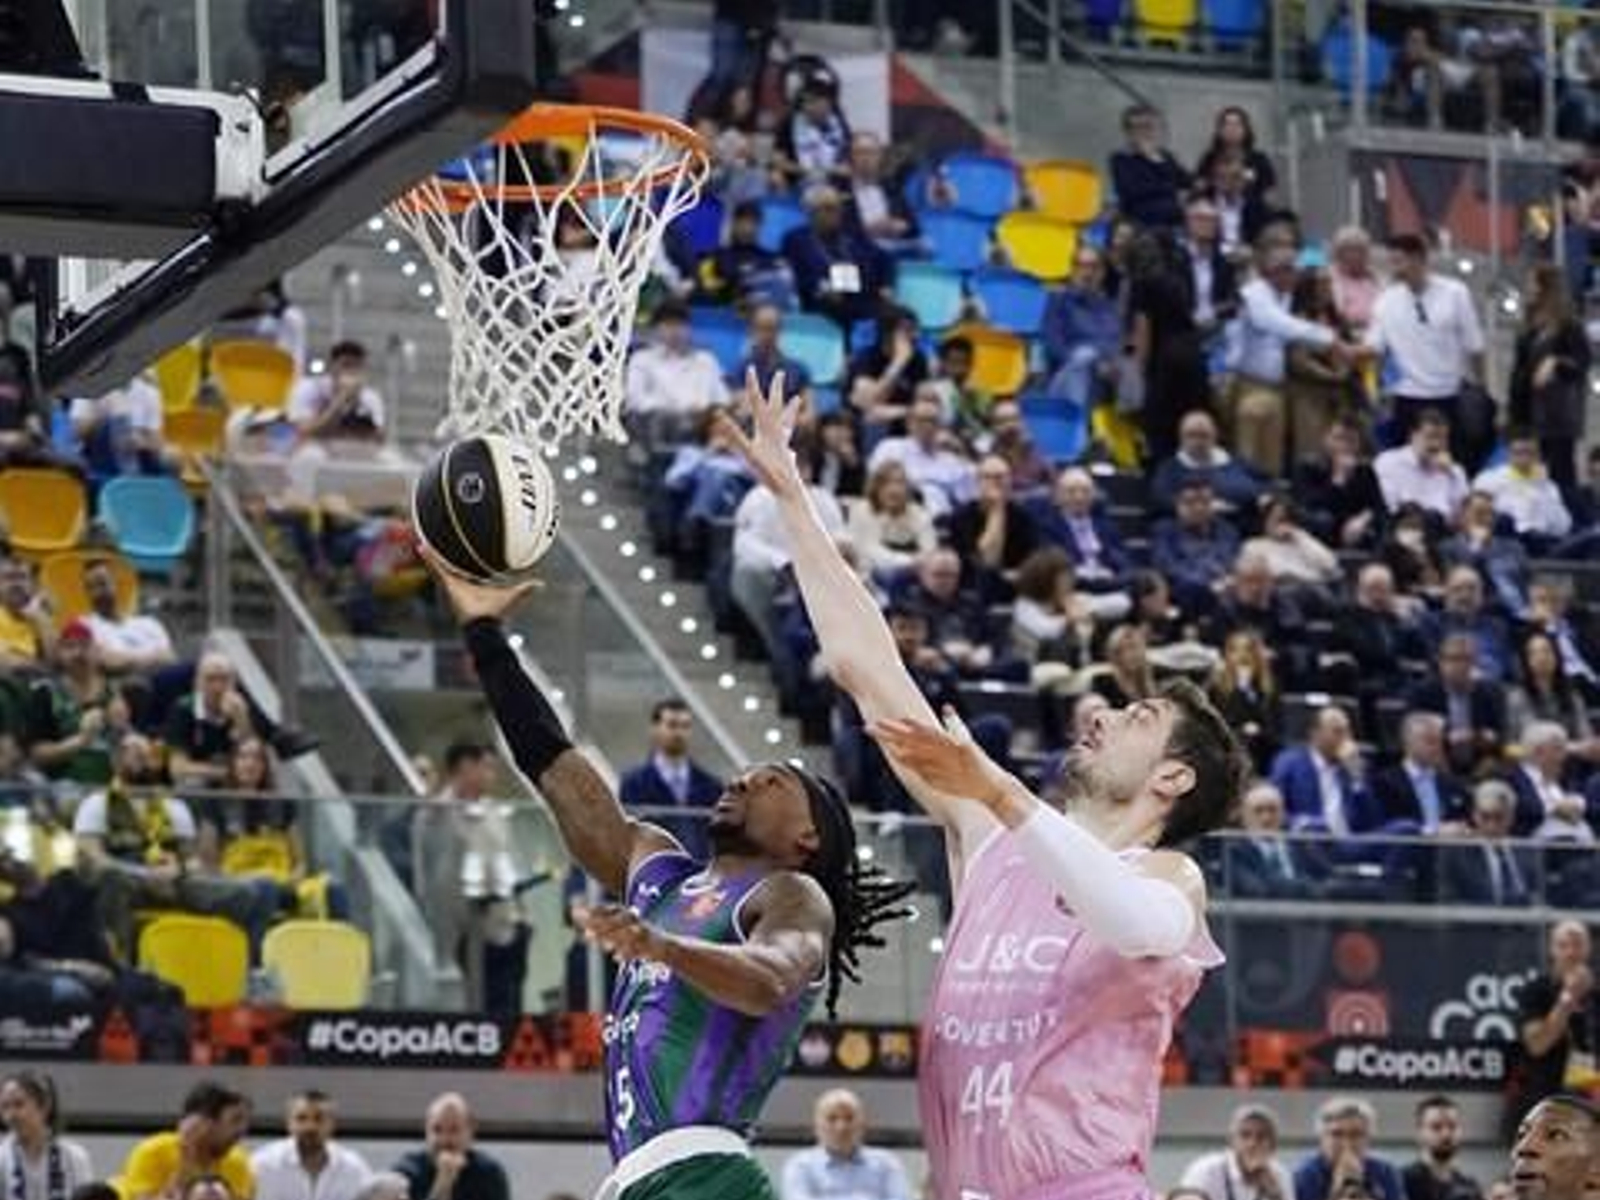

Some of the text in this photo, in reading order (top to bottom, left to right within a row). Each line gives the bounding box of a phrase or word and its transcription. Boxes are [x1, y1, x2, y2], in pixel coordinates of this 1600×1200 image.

[956, 934, 1068, 973] J&C
[1466, 970, 1538, 1010] ac
[308, 1018, 500, 1058] #CopaACB
[1334, 1046, 1503, 1082] #CopaACB
[961, 1061, 1014, 1131] 44
